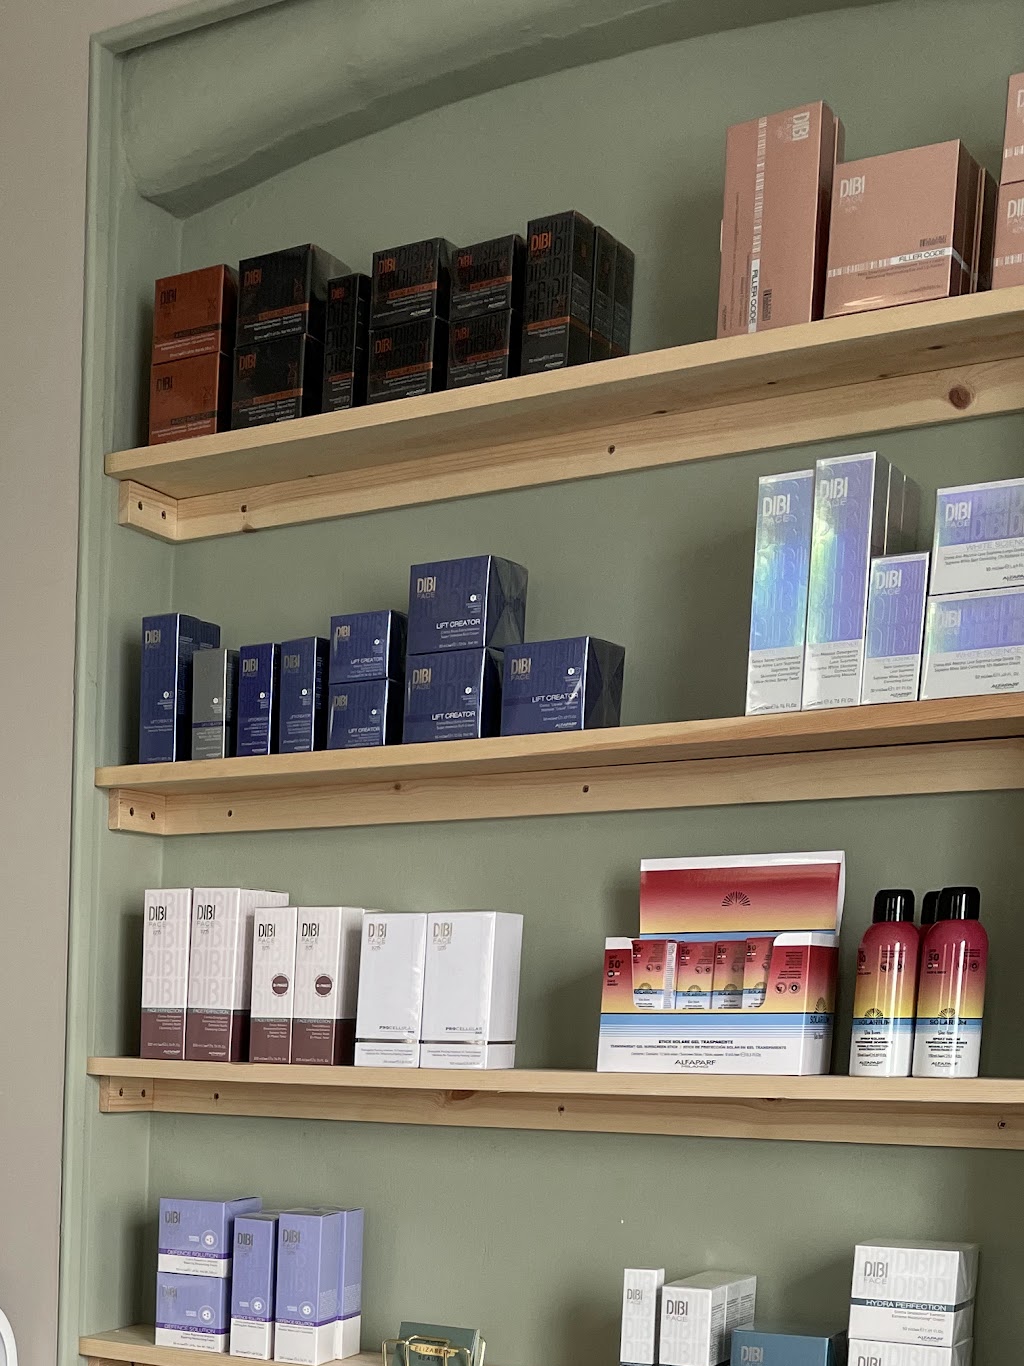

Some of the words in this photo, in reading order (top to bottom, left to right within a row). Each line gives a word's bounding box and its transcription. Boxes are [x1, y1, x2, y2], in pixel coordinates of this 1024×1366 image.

[792, 112, 810, 141] DIBI
[839, 175, 866, 198] DIBI
[531, 232, 552, 251] DIBI
[457, 255, 473, 268] DIBI
[898, 252, 924, 264] FILLER
[925, 249, 945, 259] CODE
[378, 257, 396, 274] DIBI
[244, 268, 262, 287] DIBI
[160, 288, 177, 305] DIBI
[454, 326, 470, 340] DIBI
[375, 338, 392, 353] DIBI
[239, 353, 256, 371] DIBI
[156, 376, 173, 392] DIBI
[819, 477, 849, 499] DIBI
[763, 493, 791, 517] DIBI
[945, 501, 972, 522] DIBI
[966, 542, 992, 551] WHITE
[417, 576, 437, 593] DIBI
[876, 569, 902, 590] DIBI
[436, 621, 449, 630] LIFT
[449, 618, 481, 628] CREATOR
[937, 609, 962, 629] DIBI
[145, 630, 161, 644] DIBI
[336, 625, 351, 638] DIBI
[956, 650, 981, 658] WHITE
[983, 647, 1021, 655] SCIENCE
[243, 658, 259, 673] DIBI
[283, 654, 300, 669] DIBI
[511, 658, 532, 675] DIBI
[412, 668, 432, 685] DIBI
[333, 694, 348, 708] DIBI
[546, 692, 579, 701] CREATOR
[431, 713, 444, 721] LIFT
[445, 710, 476, 719] CREATOR
[149, 906, 167, 921] DIBI
[197, 904, 216, 921] DIBI
[258, 923, 276, 938] DIBI
[302, 922, 320, 937] DIBI
[368, 923, 387, 938] DIBI
[433, 922, 453, 938] DIBI
[608, 960, 624, 969] 50+
[165, 1210, 181, 1224] DIBI
[237, 1232, 254, 1246] DIBI
[283, 1229, 301, 1244] DIBI
[193, 1251, 219, 1259] SOLUTION
[864, 1261, 889, 1278] DIBI
[864, 1277, 887, 1285] FACE
[162, 1285, 178, 1299] DIBI
[627, 1288, 643, 1300] DIBI
[666, 1300, 689, 1316] DIBI
[865, 1300, 894, 1308] HYDRA
[895, 1301, 947, 1311] PERFECTION
[666, 1315, 688, 1323] FACE
[189, 1326, 216, 1334] SOLUTION
[414, 1345, 452, 1355] ELIZABEH
[740, 1345, 764, 1362] DIBI
